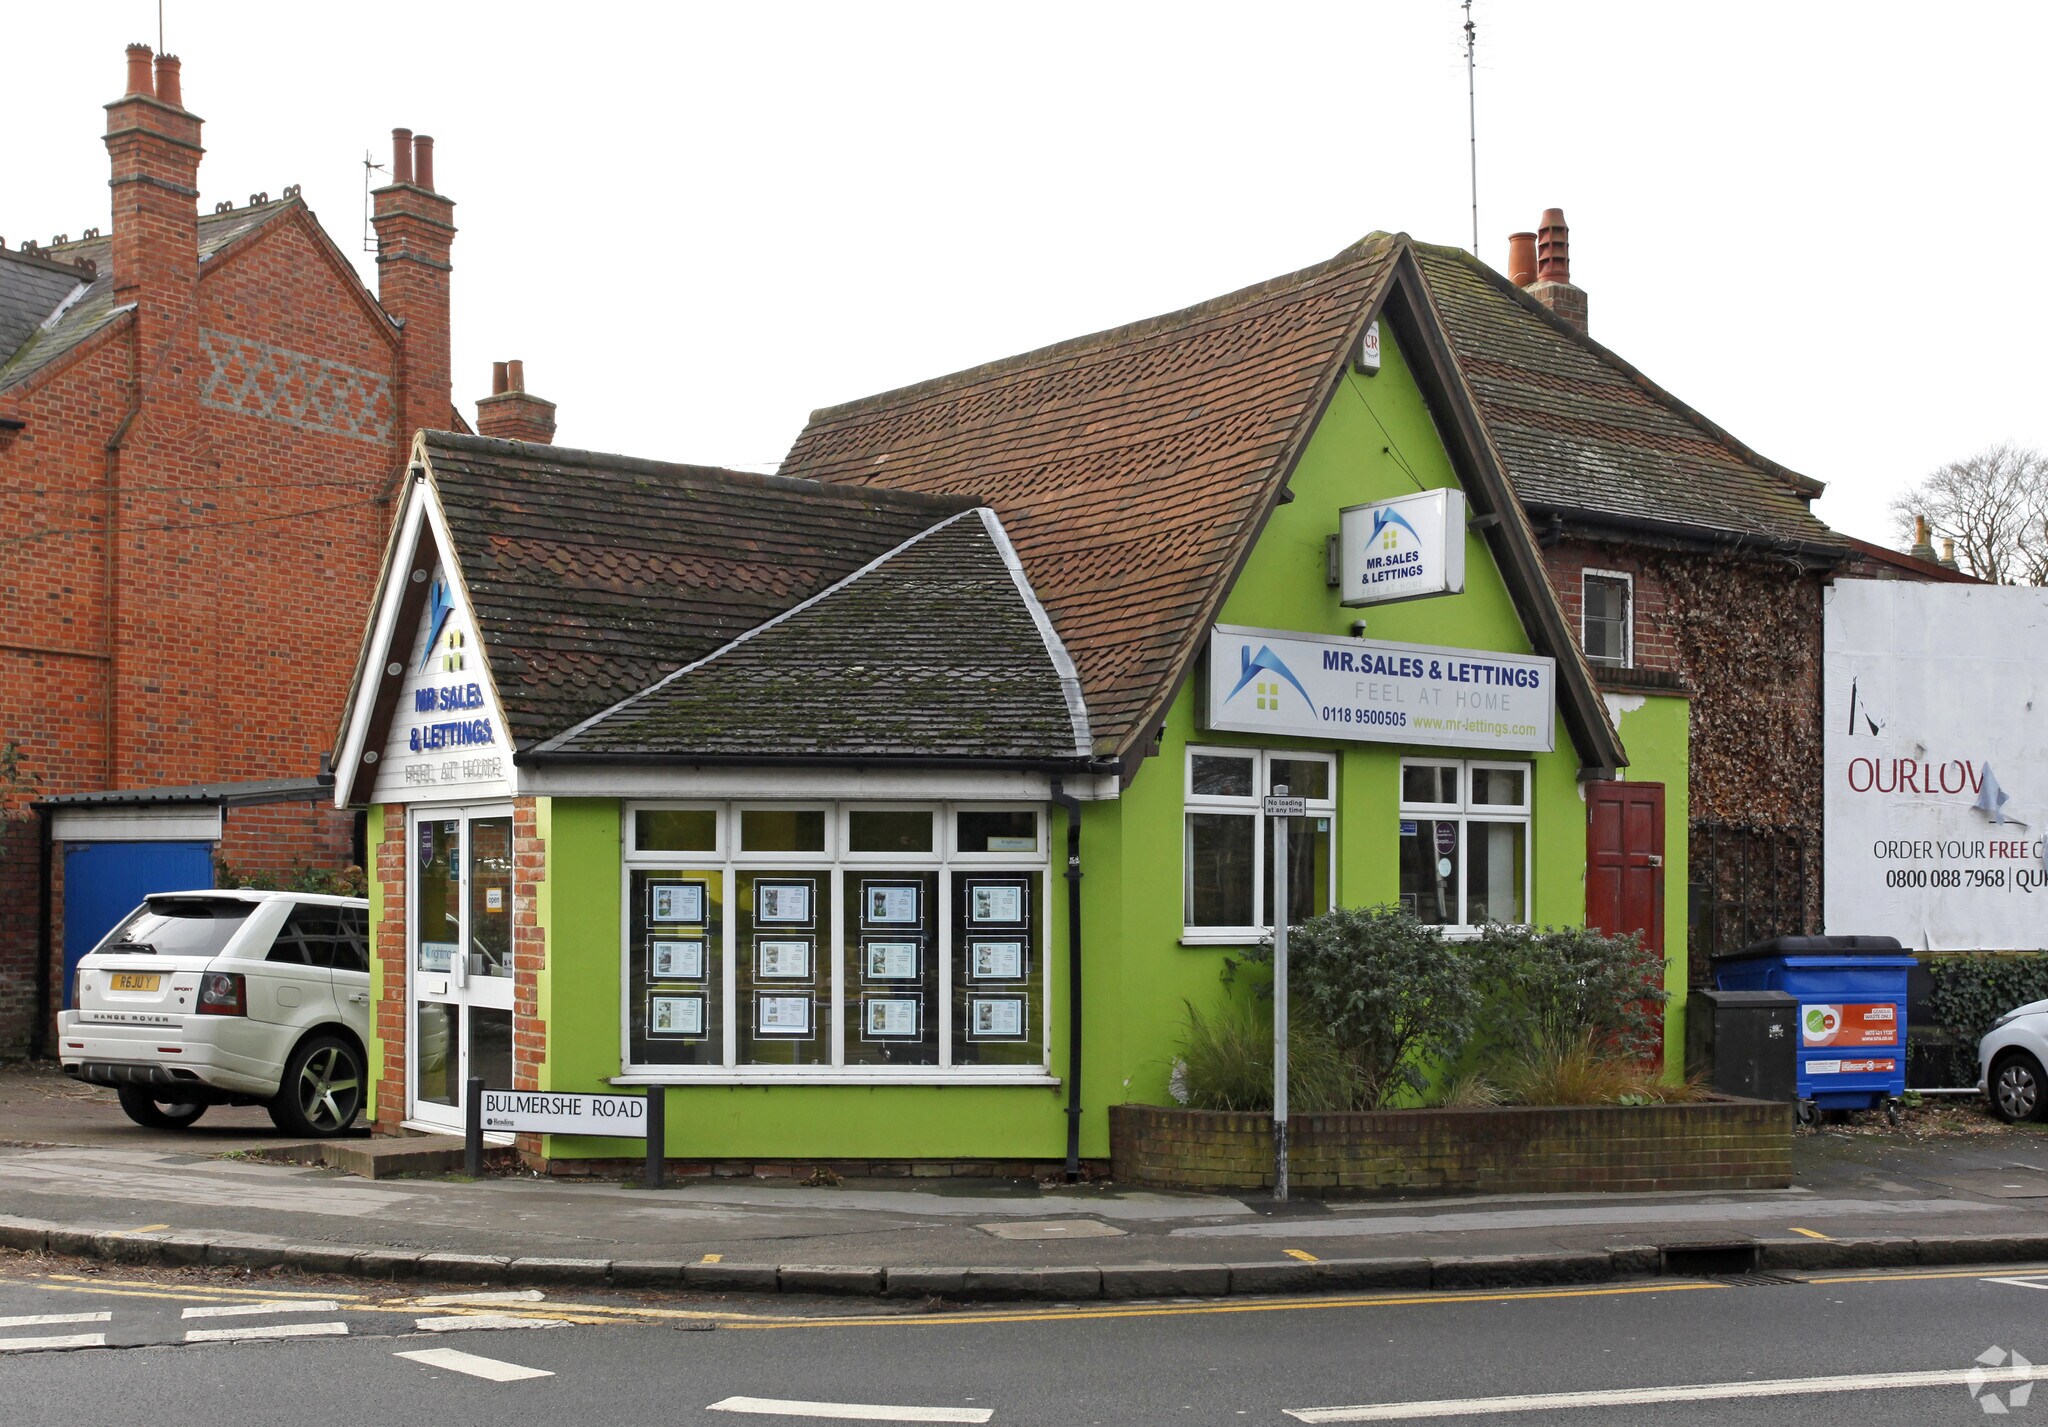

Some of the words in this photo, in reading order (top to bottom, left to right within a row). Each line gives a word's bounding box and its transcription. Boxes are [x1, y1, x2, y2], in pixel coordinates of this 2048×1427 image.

[1366, 551, 1419, 570] MR.SALES
[1361, 573, 1369, 585] &
[1371, 564, 1423, 583] LETTINGS
[1323, 650, 1424, 678] MR.SALES
[1428, 660, 1442, 680] &
[1447, 662, 1540, 689] LETTINGS
[1355, 681, 1404, 703] FEEL
[1418, 687, 1442, 706] AT
[1456, 690, 1510, 712] HOME
[1322, 706, 1352, 723] 0118
[1355, 708, 1406, 727] 9500505
[1413, 716, 1537, 738] www.mr-lettings.com
[409, 727, 420, 751] &
[423, 718, 495, 749] LETTINGS
[1848, 757, 1921, 794] OUR
[1279, 799, 1303, 807] loading
[1873, 840, 1934, 859] ORDER
[1936, 840, 1986, 859] YOUR
[1989, 841, 2029, 859] FREE
[1886, 869, 1927, 888] 0800
[1930, 869, 1961, 888] 088
[1964, 869, 2005, 888] 7968
[132, 1015, 169, 1023] ROVER
[486, 1094, 582, 1116] BULMERSHE
[592, 1099, 643, 1118] ROAD
[493, 1118, 515, 1126] Reading
